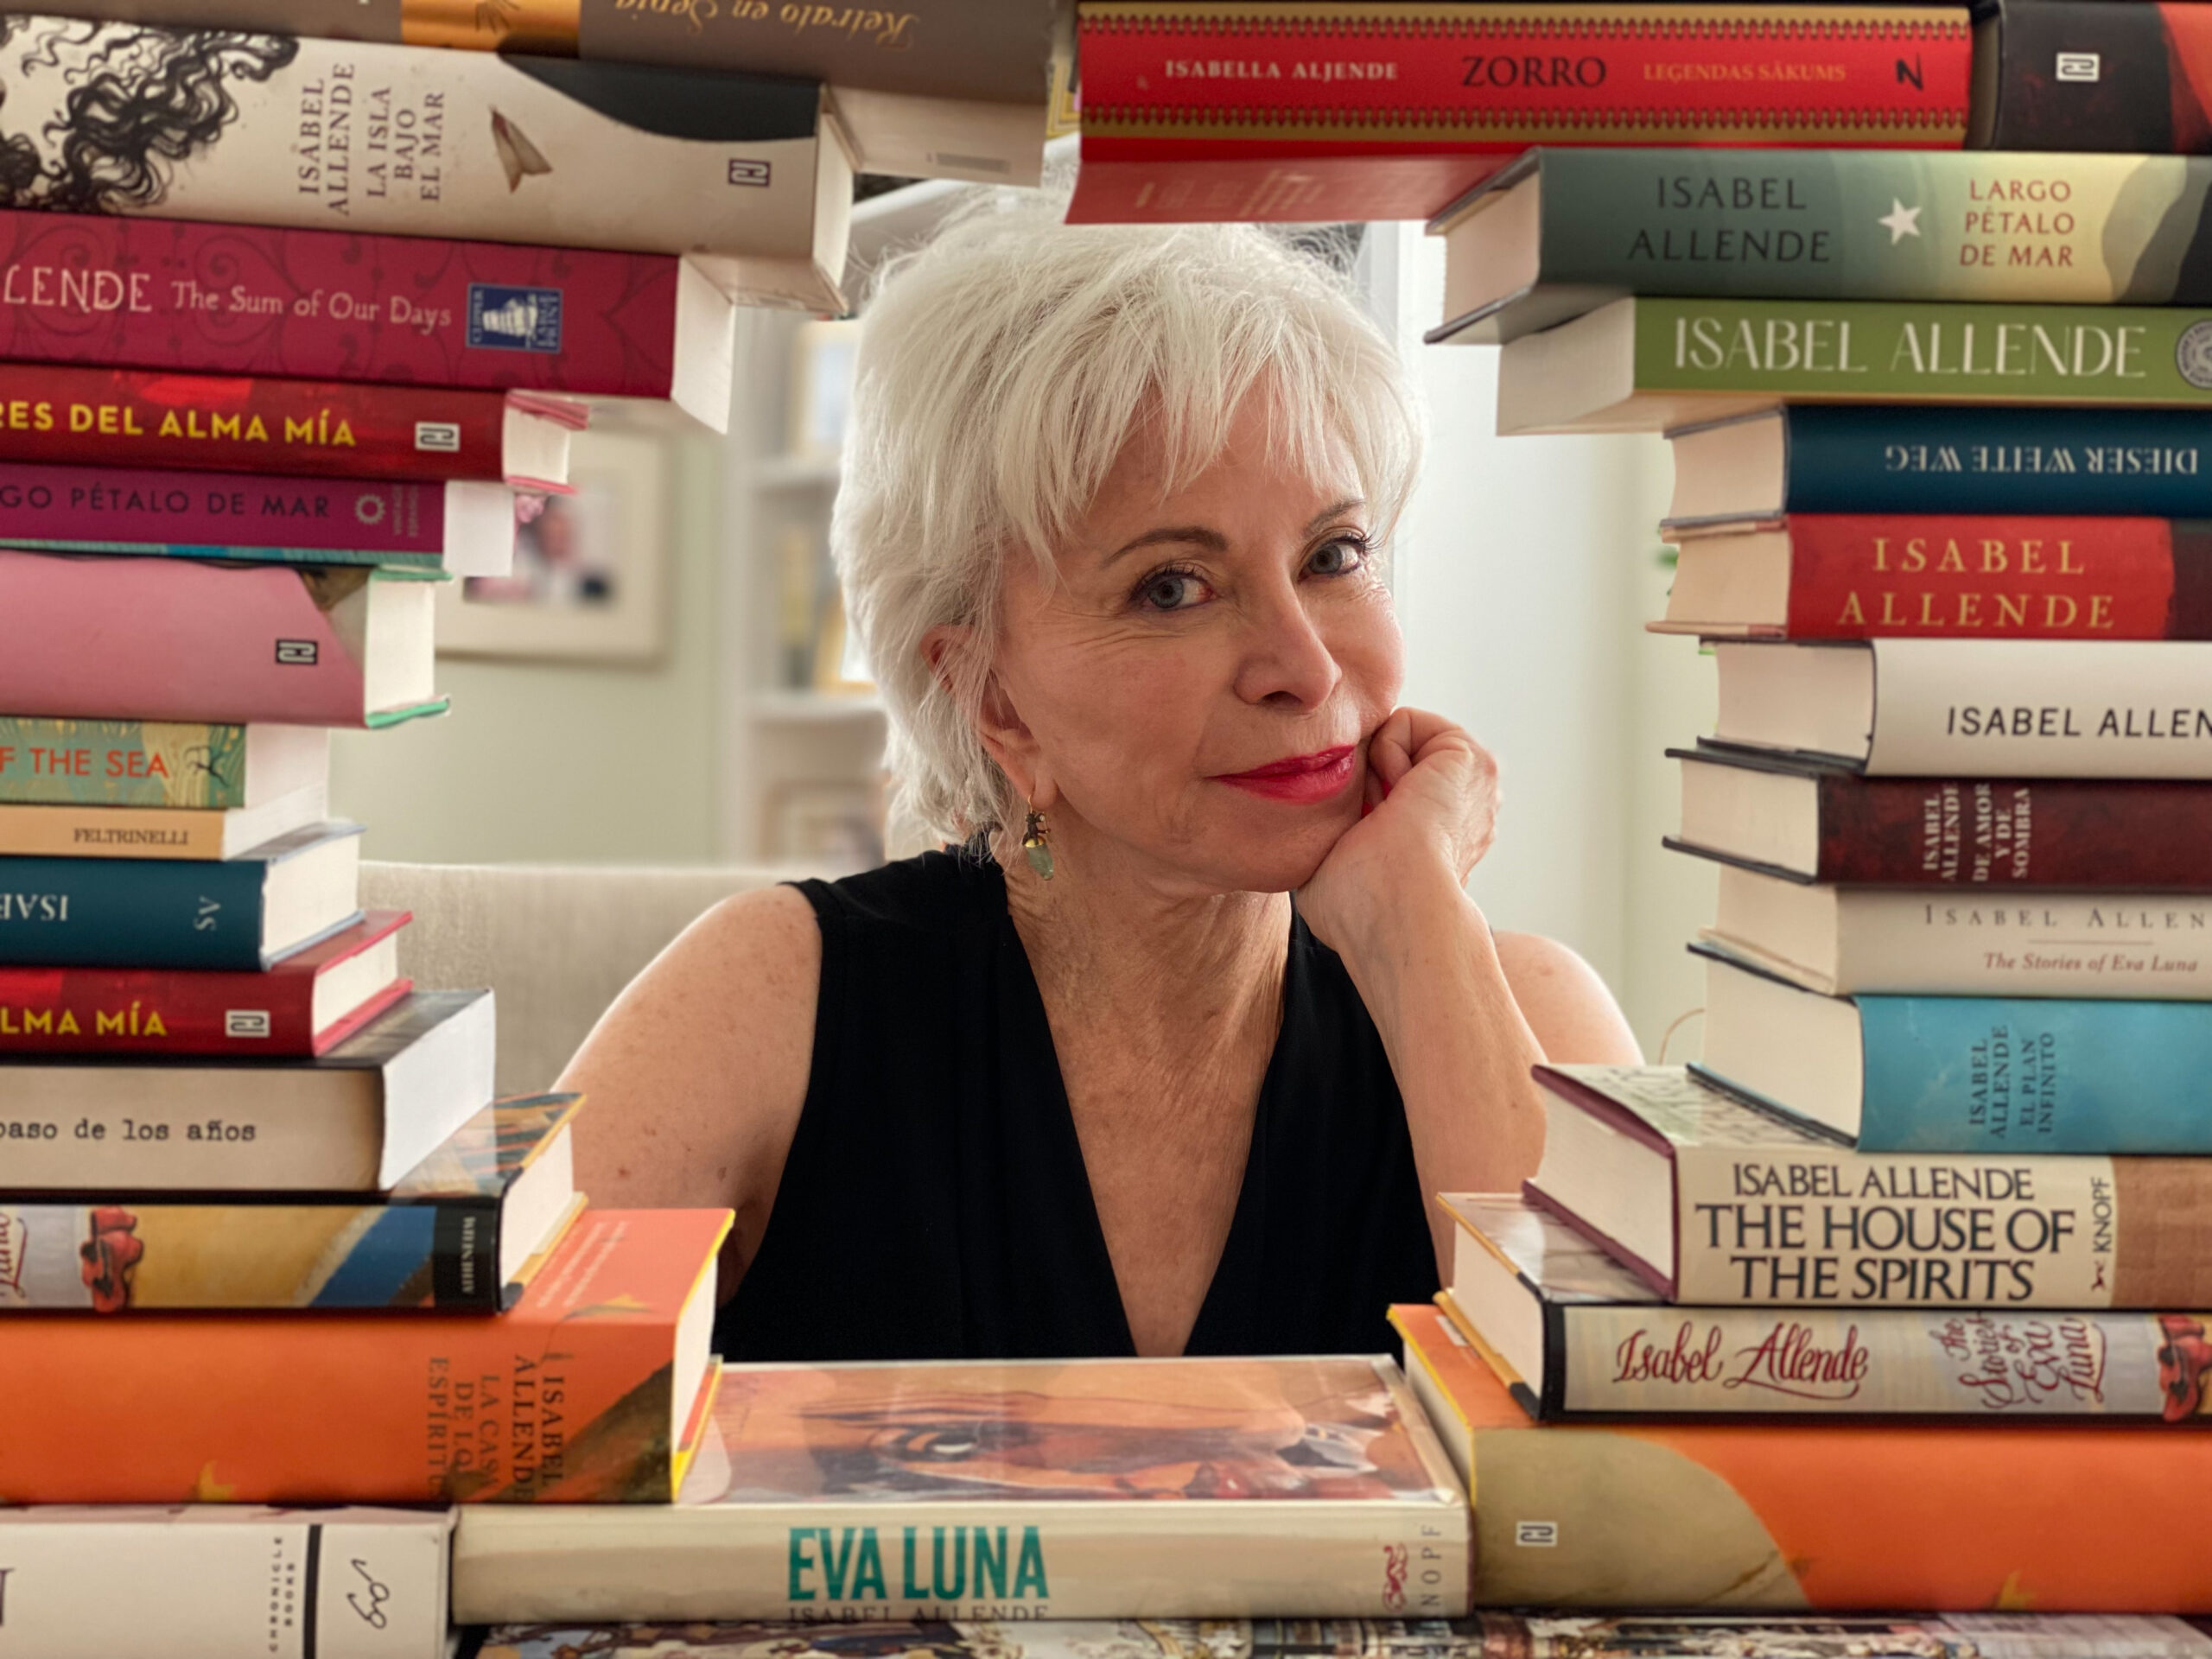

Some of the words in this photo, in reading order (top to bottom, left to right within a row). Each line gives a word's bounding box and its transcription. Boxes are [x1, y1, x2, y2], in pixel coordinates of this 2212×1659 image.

[732, 0, 770, 21] en
[780, 3, 919, 49] Retrato
[1166, 60, 1281, 79] ISABELLA
[1293, 61, 1398, 82] ALJENDE
[1462, 56, 1605, 87] ZORRO
[1758, 60, 1846, 81] SĀKUMS
[299, 78, 325, 195] ISABEL
[328, 63, 355, 215] ALLENDE
[374, 87, 392, 152] ISLA
[424, 92, 445, 161] MAR
[395, 109, 416, 181] BAJO
[366, 161, 386, 199] LA
[421, 168, 441, 202] EL
[1657, 177, 1807, 210] ISABEL
[1969, 179, 2071, 202] LARGO
[1965, 207, 2075, 234] PÉTALO
[1628, 230, 1831, 263] ALLENDE
[1960, 245, 1995, 266] DE
[2008, 246, 2074, 268] MAR
[3, 265, 152, 314] LENDE
[172, 281, 219, 311] The
[230, 287, 284, 315] Sum
[294, 290, 324, 318] of
[329, 292, 380, 321] Our
[390, 296, 452, 337] Days
[1675, 317, 1868, 372] ISABEL
[1890, 322, 2145, 378] ALLENDE
[0, 400, 53, 430] ES
[70, 403, 143, 435] DEL
[159, 410, 269, 442] ALMA
[285, 409, 356, 446] MÍA
[1885, 445, 1962, 472] WEG
[1973, 446, 2075, 474] WEITE
[2088, 448, 2199, 474] DIESER
[0, 485, 52, 510] GO
[71, 482, 191, 514] PÉTALO
[207, 492, 245, 516] DE
[262, 493, 329, 518] MAR
[1872, 537, 2085, 575] ISABEL
[1837, 591, 2114, 629] ALLENDE
[1947, 707, 2082, 736] ISABEL
[29, 747, 91, 776] THE
[105, 749, 169, 779] SEA
[1923, 794, 1940, 870] ISABEL
[1941, 783, 1961, 880] ALLENDE
[1974, 783, 1993, 848] AMOR
[1995, 809, 2012, 839] DE
[2012, 788, 2031, 879] SOMBRA
[73, 828, 188, 845] FELTRINELLI
[1995, 844, 2011, 858] Y
[1972, 852, 1991, 881] DE
[194, 895, 221, 931] SV
[1925, 905, 2058, 927] ISABEL
[2088, 908, 2206, 930] ALLEN
[1985, 953, 2016, 970] The
[2023, 953, 2082, 972] Stories
[2088, 953, 2107, 973] of
[2112, 955, 2145, 973] Eva
[2152, 955, 2198, 974] Luna
[96, 1001, 167, 1035] MÍA
[1969, 1039, 1988, 1126] ISABEL
[1989, 1025, 2009, 1139] ALLENDE
[2020, 1039, 2037, 1095] PLAN
[2037, 1032, 2056, 1134] INFINITO
[74, 1119, 106, 1141] de
[123, 1120, 169, 1141] los
[187, 1122, 257, 1142] años
[2018, 1102, 2037, 1127] EL
[1733, 1164, 1852, 1198] ISABEL
[1860, 1166, 2035, 1200] ALLENDE
[1695, 1204, 1806, 1249] THE
[1822, 1205, 1995, 1252] HOUSE
[2006, 1209, 2075, 1254] OF
[2092, 1176, 2112, 1252] KNOPF
[1730, 1256, 1840, 1299] THE
[1851, 1257, 2036, 1300] SPIRITS
[1929, 1318, 1971, 1362] The
[1998, 1324, 2025, 1354] of
[1612, 1321, 1724, 1384] Isabel
[1723, 1322, 1869, 1401] Allende
[1958, 1311, 2027, 1408] Stories
[2013, 1319, 2062, 1404] Eva
[2057, 1316, 2107, 1403] Luna
[454, 1382, 474, 1421] DE
[480, 1375, 499, 1409] LA
[429, 1357, 453, 1498] ESPÍRITU
[513, 1354, 537, 1502] ALLENDE
[543, 1376, 564, 1487] ISABEL
[788, 1527, 888, 1601] EVA
[902, 1525, 1049, 1599] LUNA
[269, 1536, 283, 1652] CHRONICLE
[284, 1562, 296, 1626] BOOKS
